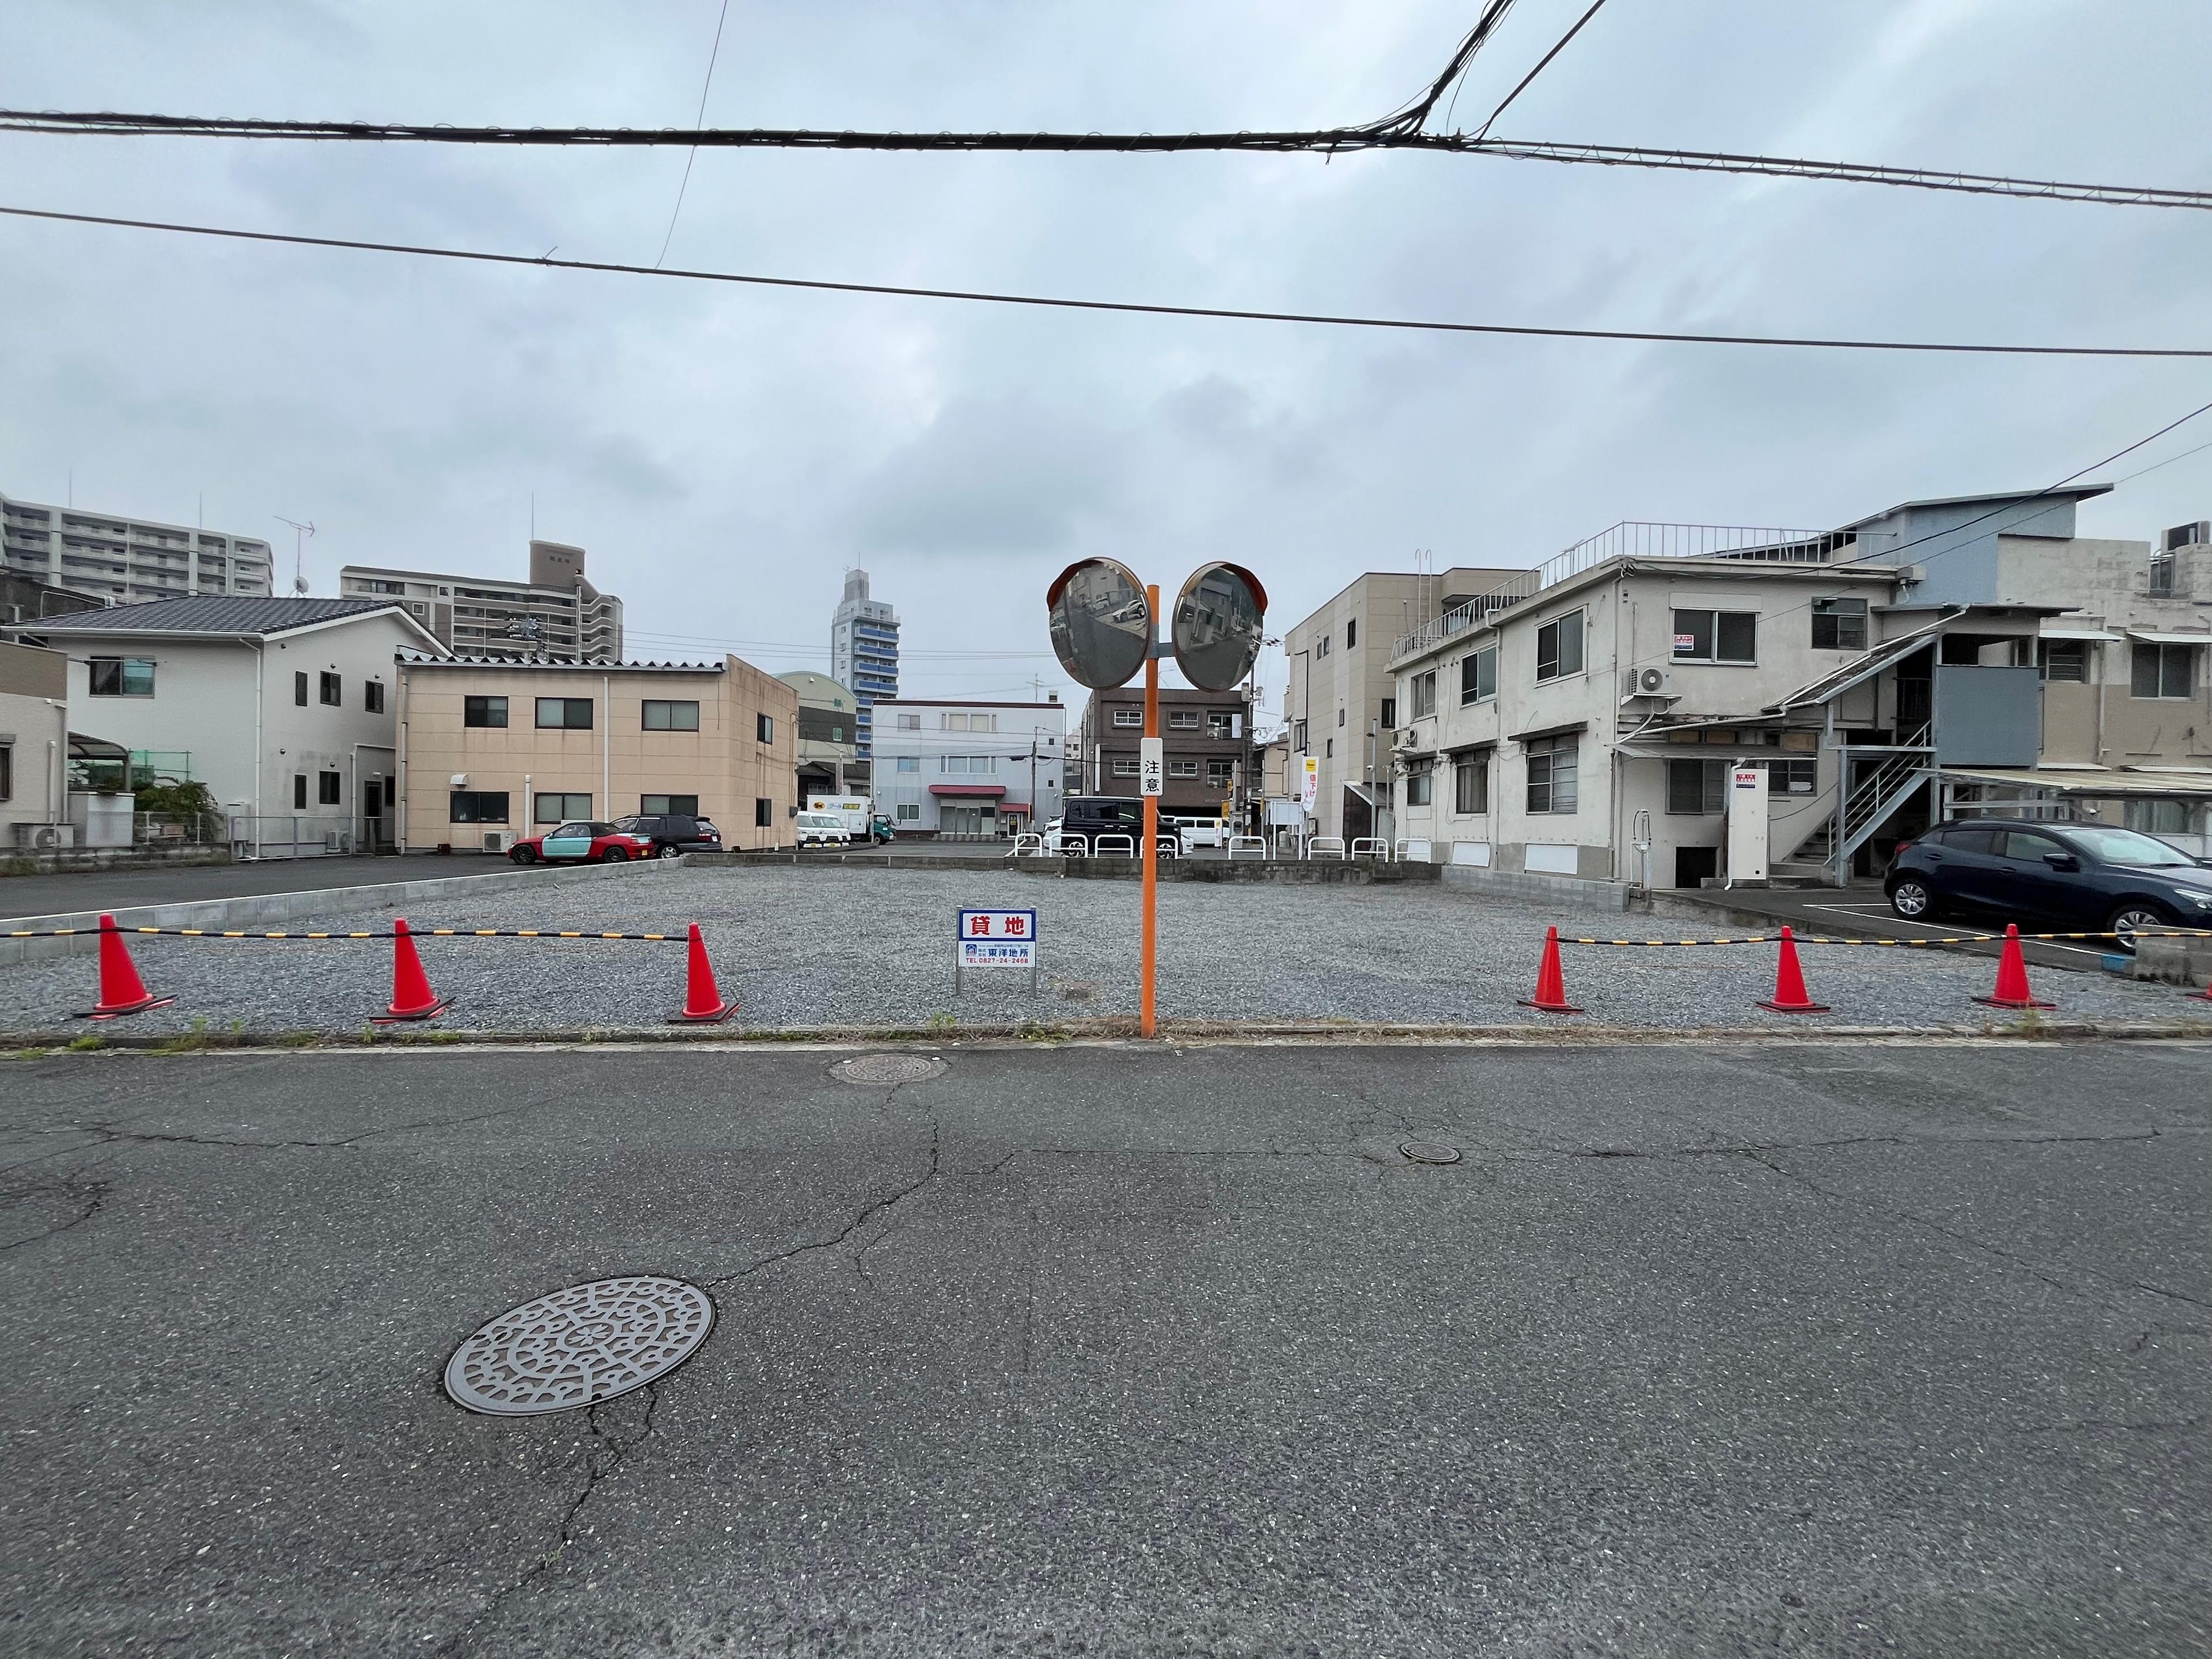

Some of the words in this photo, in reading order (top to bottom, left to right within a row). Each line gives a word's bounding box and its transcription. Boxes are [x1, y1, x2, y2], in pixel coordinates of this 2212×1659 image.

[1145, 760, 1160, 791] 注意
[971, 915, 1024, 935] 貸地
[988, 949, 1028, 957] 東洋地所
